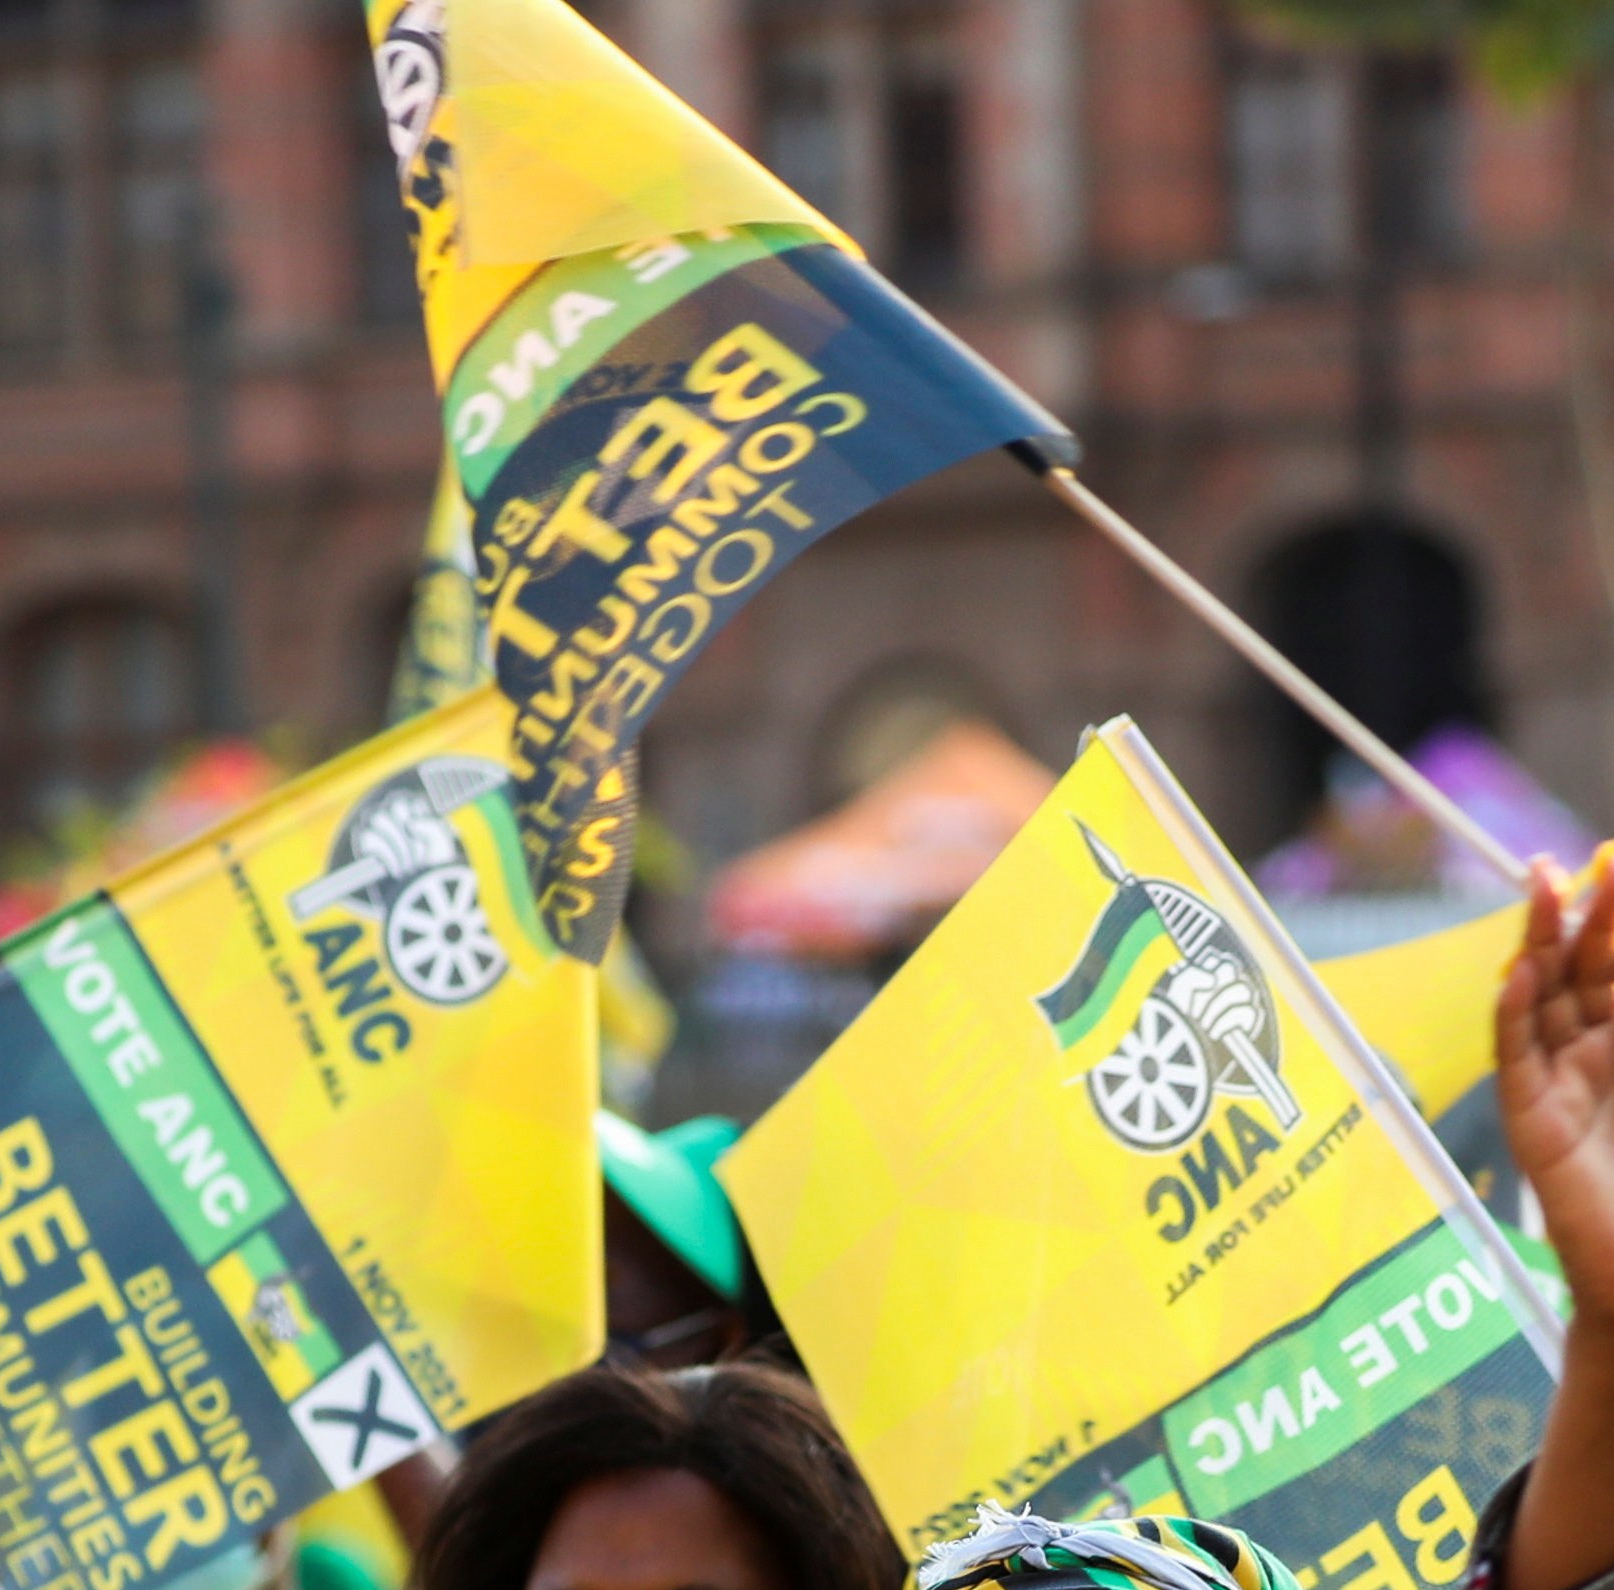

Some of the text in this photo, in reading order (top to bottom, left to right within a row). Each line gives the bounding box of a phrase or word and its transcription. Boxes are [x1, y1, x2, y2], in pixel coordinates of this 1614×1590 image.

[40, 920, 251, 1230] VOTE ANC
[301, 922, 412, 1064] ANC
[123, 1265, 278, 1526] BUILDING
[359, 1260, 418, 1333] NOV
[404, 1339, 469, 1417] 2021
